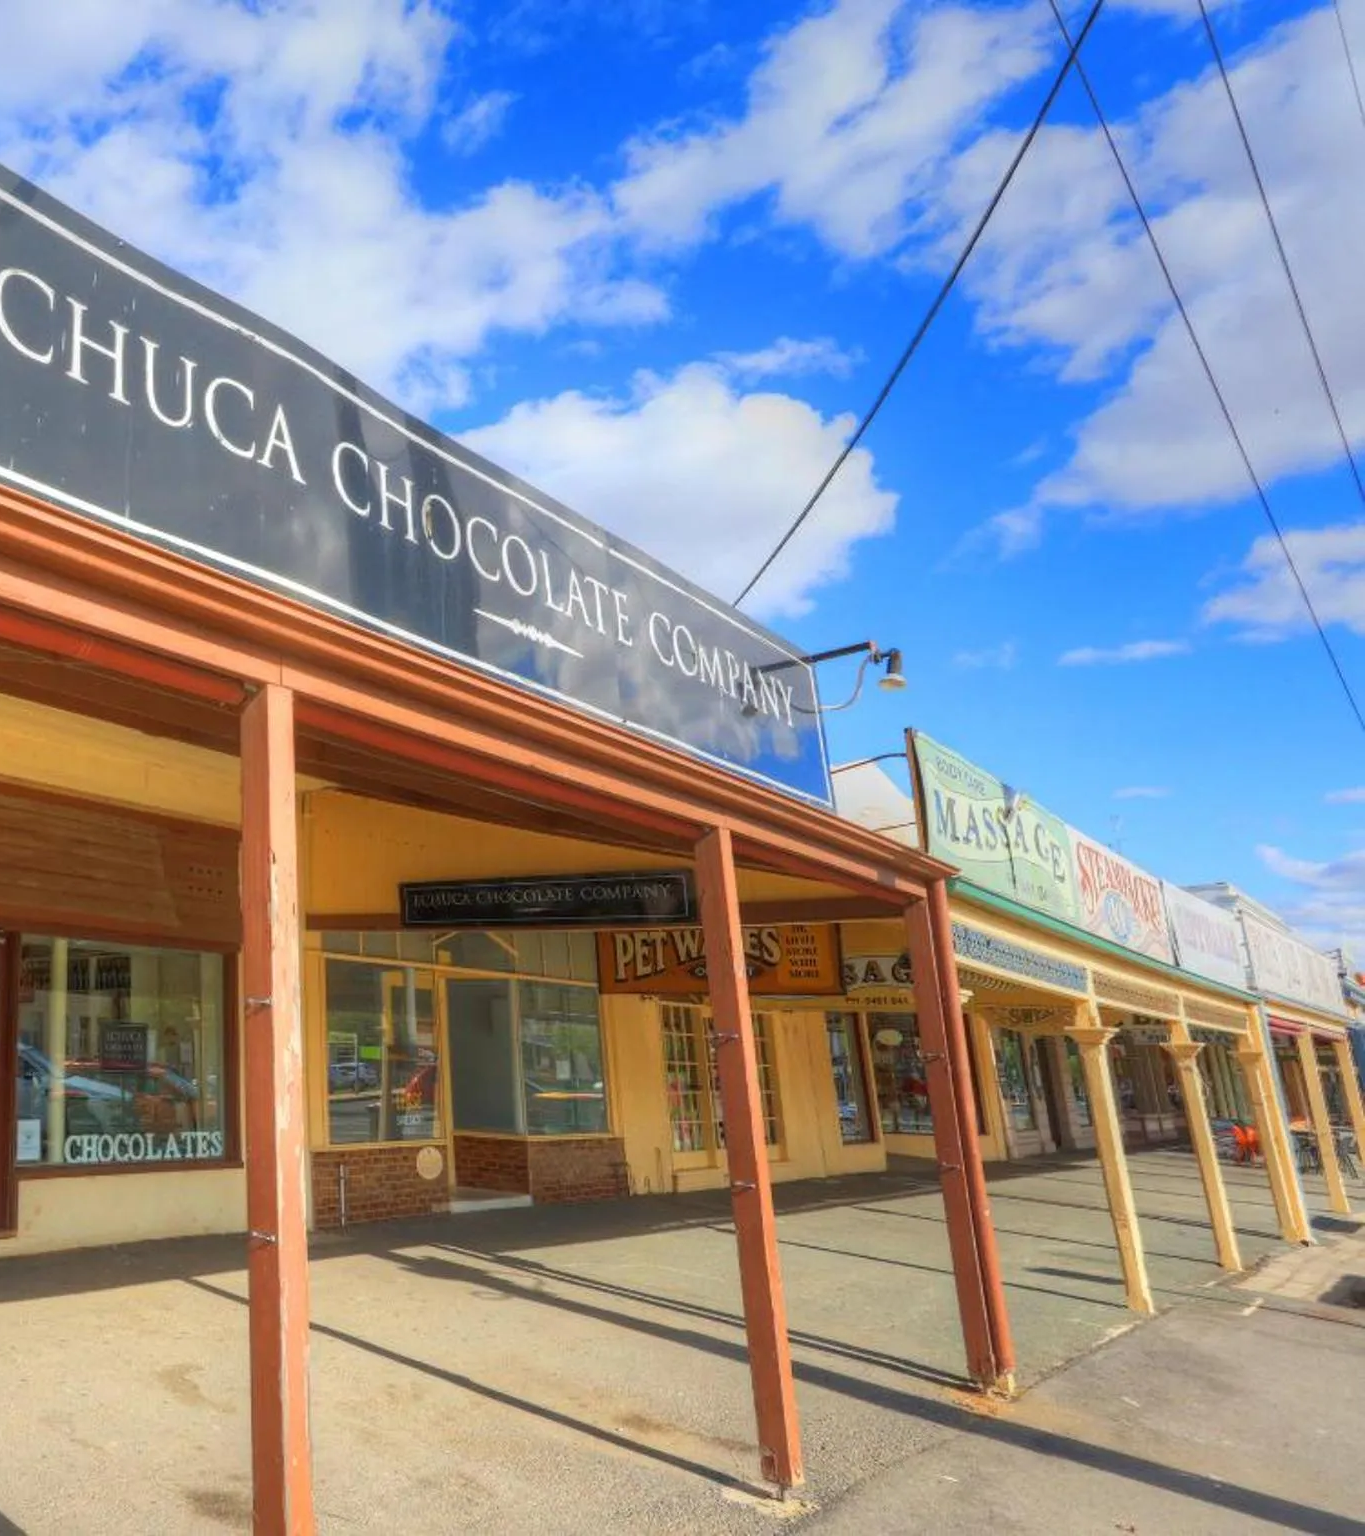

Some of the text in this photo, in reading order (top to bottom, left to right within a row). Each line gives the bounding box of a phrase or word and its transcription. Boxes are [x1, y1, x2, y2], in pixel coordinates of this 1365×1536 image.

[332, 441, 633, 647] CHOCOLATE
[648, 611, 794, 728] COMPANY
[934, 789, 1066, 883] MASSAGE
[413, 882, 672, 908] ECHUCA CHOCOLATE COMPANY
[613, 926, 782, 982] PET WES
[64, 1131, 223, 1164] CHOCOLATES
